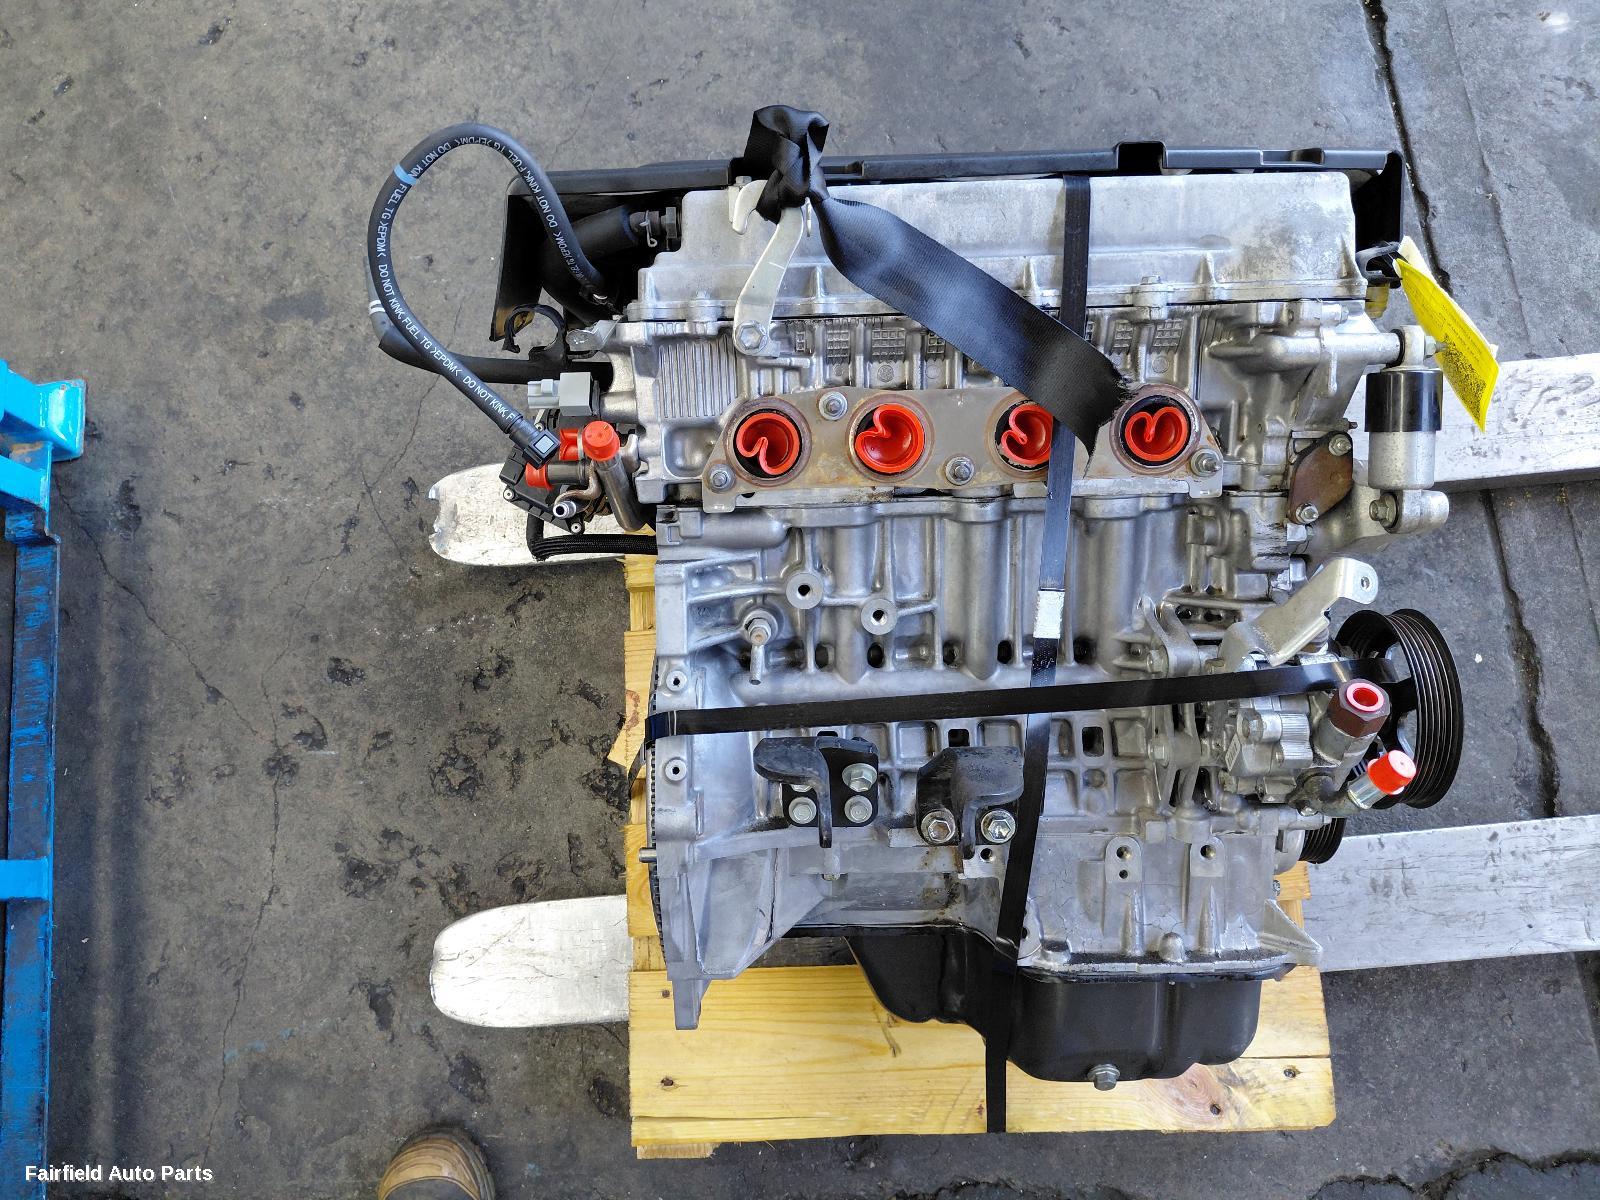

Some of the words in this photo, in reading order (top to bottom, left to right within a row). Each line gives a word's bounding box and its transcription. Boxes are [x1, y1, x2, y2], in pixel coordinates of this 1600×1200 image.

[437, 142, 453, 154] DO
[493, 141, 506, 153] TG
[421, 150, 440, 168] NOT
[508, 149, 528, 173] FUEL
[407, 164, 424, 178] KIN
[387, 183, 408, 205] FUEL
[536, 195, 551, 213] NOT
[381, 207, 395, 220] TG
[546, 214, 558, 228] DO
[378, 264, 389, 278] DO
[381, 278, 395, 297] NOT
[401, 316, 421, 340] FUEL
[420, 336, 433, 350] TG
[462, 375, 476, 389] DO
[474, 386, 493, 402] NOT
